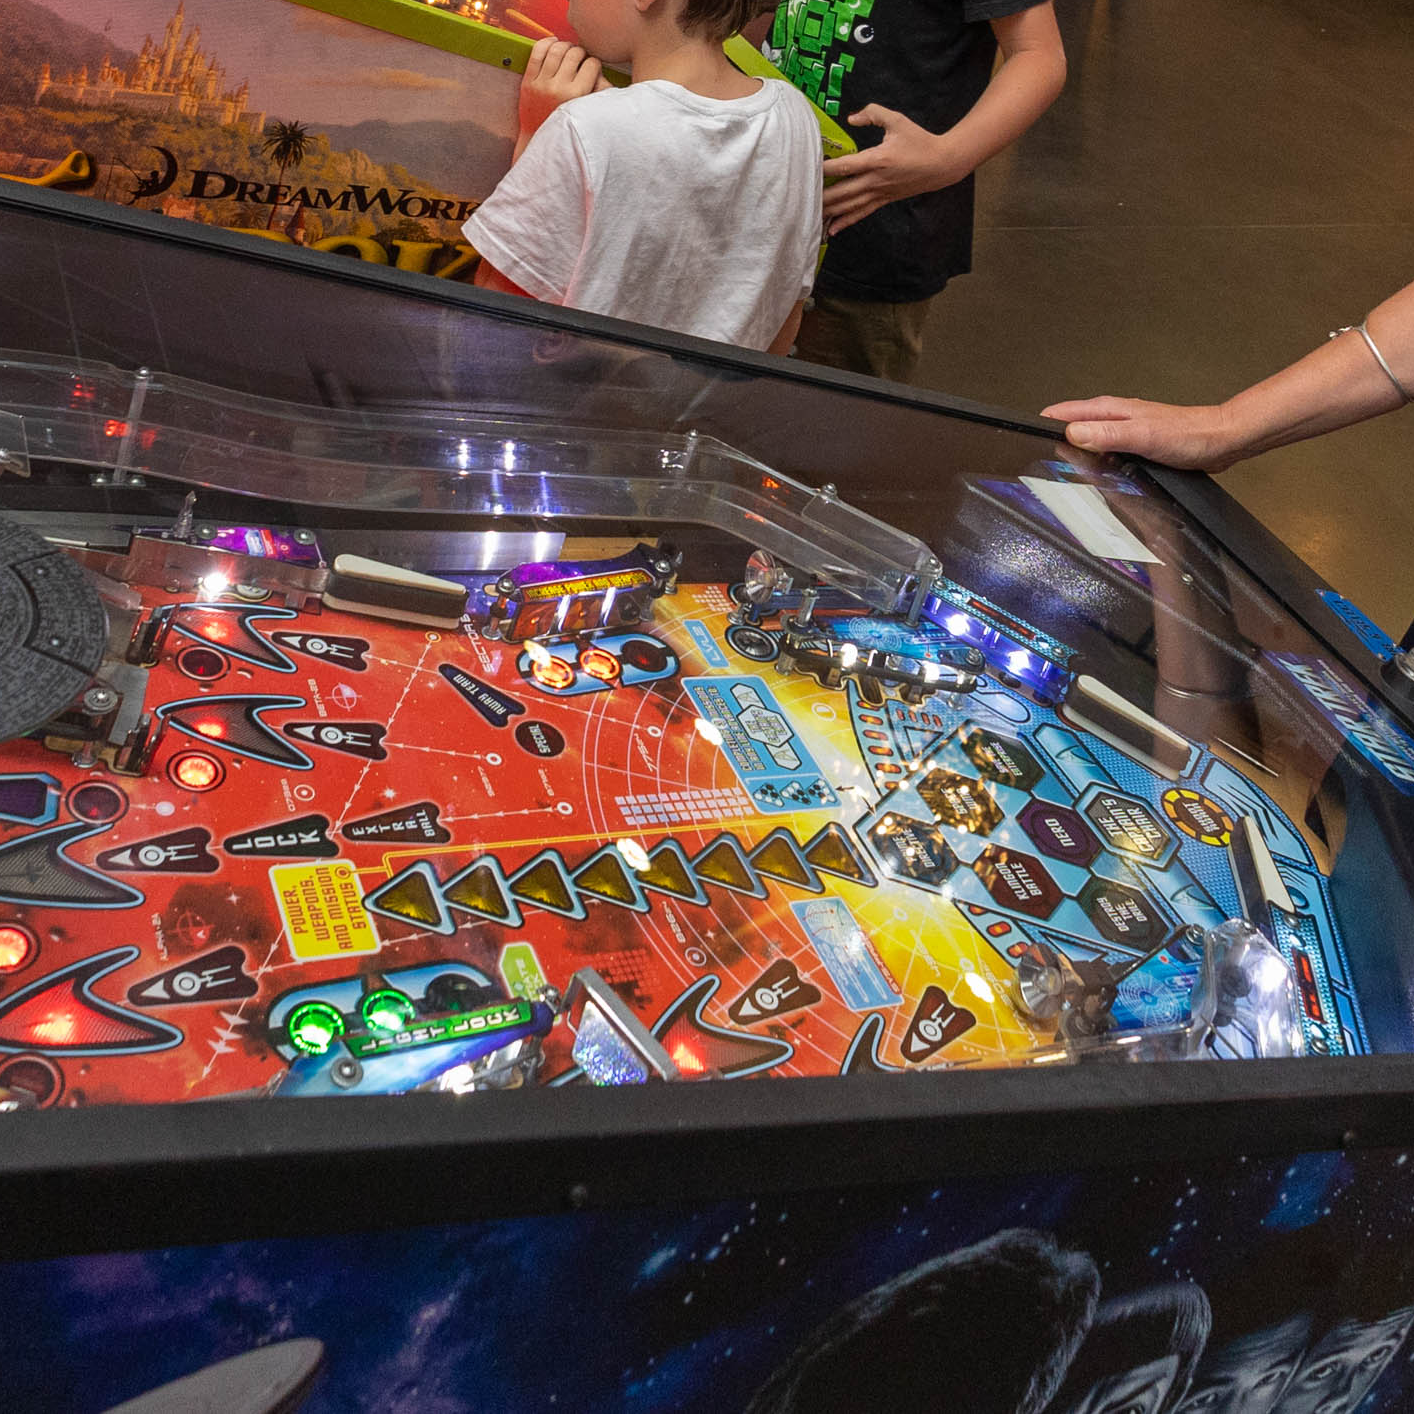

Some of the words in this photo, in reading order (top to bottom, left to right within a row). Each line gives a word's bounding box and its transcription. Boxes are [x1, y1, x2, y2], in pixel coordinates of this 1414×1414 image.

[183, 169, 482, 221] DREAMWORK
[692, 624, 721, 662] LVL2
[453, 673, 480, 694] TEAM
[1276, 657, 1358, 714] TREK
[480, 695, 507, 716] AWAY
[527, 724, 552, 754] SPECIAL
[991, 740, 1023, 776] ENTERPRISE
[243, 827, 322, 850] LOCK
[352, 815, 418, 837] EXTRA
[415, 809, 436, 838] BALL
[1044, 817, 1076, 847] NERO
[1098, 815, 1124, 836] THE
[1101, 796, 1156, 852] CAPTAIN'S
[1129, 807, 1163, 839] CHAIR
[901, 827, 937, 870] DIRECTIVE
[315, 867, 344, 920] MISSION
[995, 861, 1031, 900] KLINGON
[1010, 861, 1043, 896] BATTLE
[340, 882, 366, 929] STATUS
[1096, 896, 1130, 933] DESTROY
[1114, 903, 1134, 920] THE
[1123, 898, 1148, 922] DRILL
[334, 924, 354, 950] AND
[361, 1026, 446, 1052] LIGHT
[453, 1007, 520, 1032] LOCK
